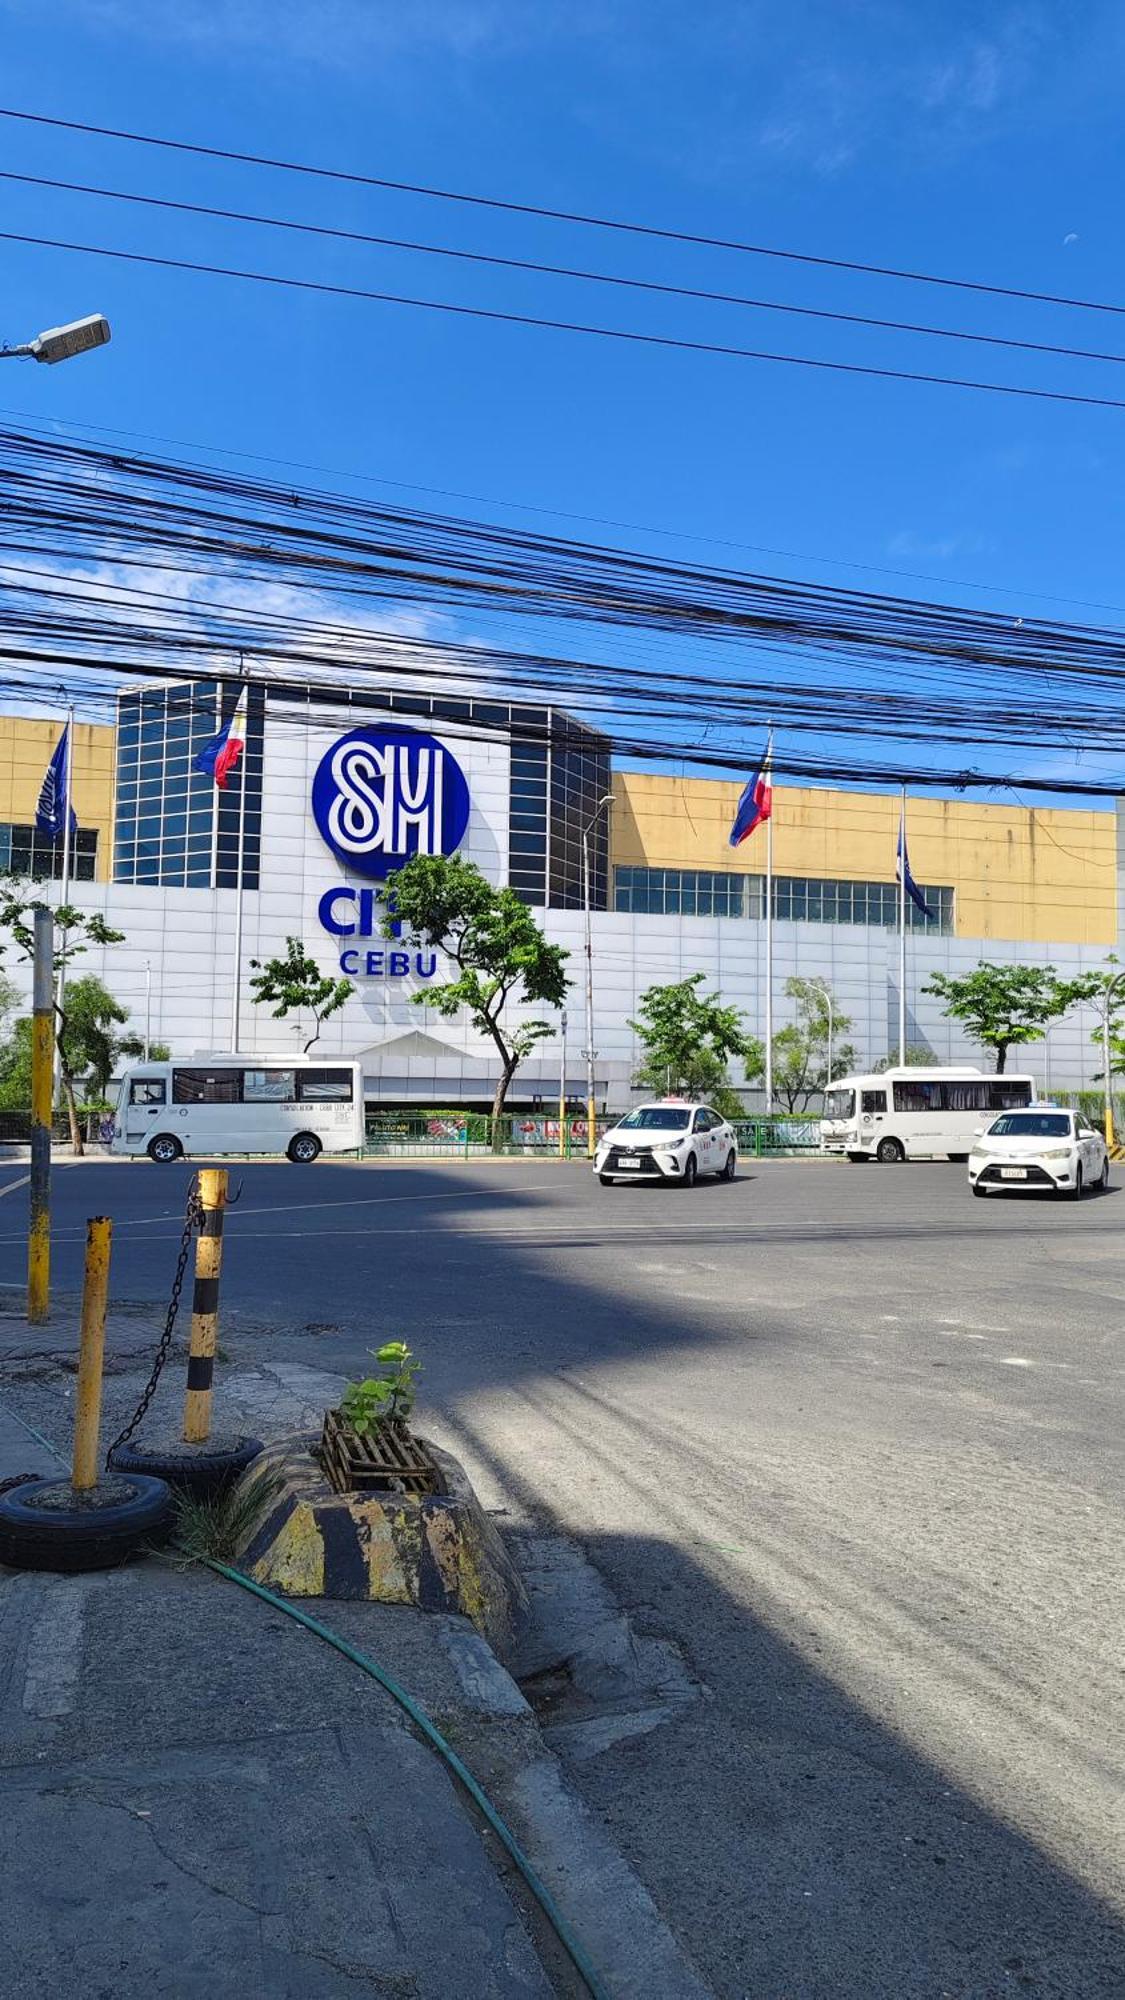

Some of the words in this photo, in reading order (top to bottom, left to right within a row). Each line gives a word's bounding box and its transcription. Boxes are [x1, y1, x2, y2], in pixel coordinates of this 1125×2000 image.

[328, 741, 443, 855] SM
[340, 951, 437, 978] CEBU
[741, 1127, 767, 1137] SAE
